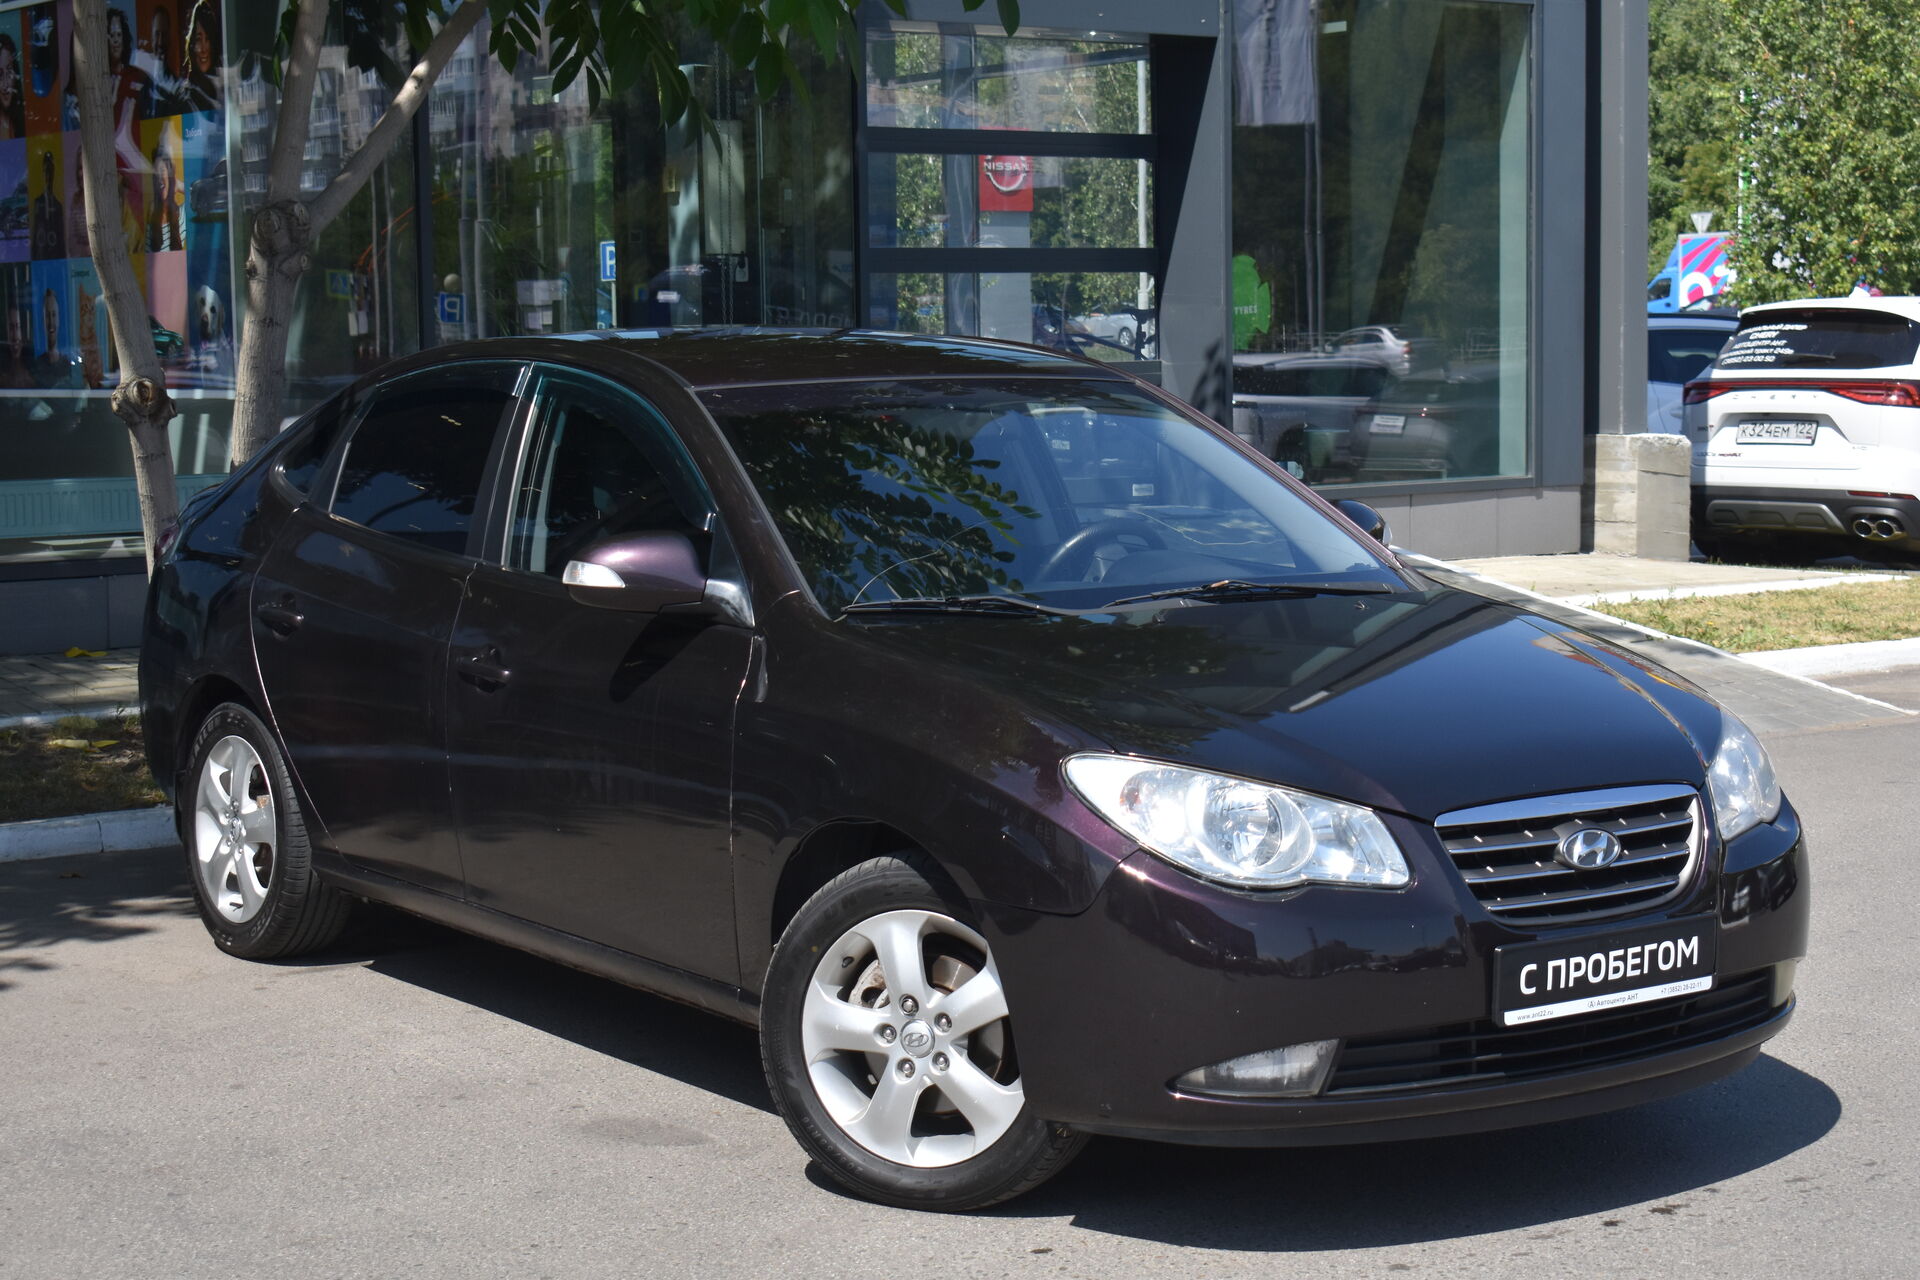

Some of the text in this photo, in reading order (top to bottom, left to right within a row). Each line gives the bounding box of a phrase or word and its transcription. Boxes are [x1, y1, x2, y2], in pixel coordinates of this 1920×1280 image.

[983, 161, 1029, 171] NISSAN
[1749, 331, 1780, 339] CHERY
[1519, 935, 1699, 995] С ПРОБЕГОМ
[1596, 996, 1627, 1007] Автоцентр
[1626, 993, 1639, 1001] АНТ
[1516, 1009, 1554, 1021] www.ant22.ru
